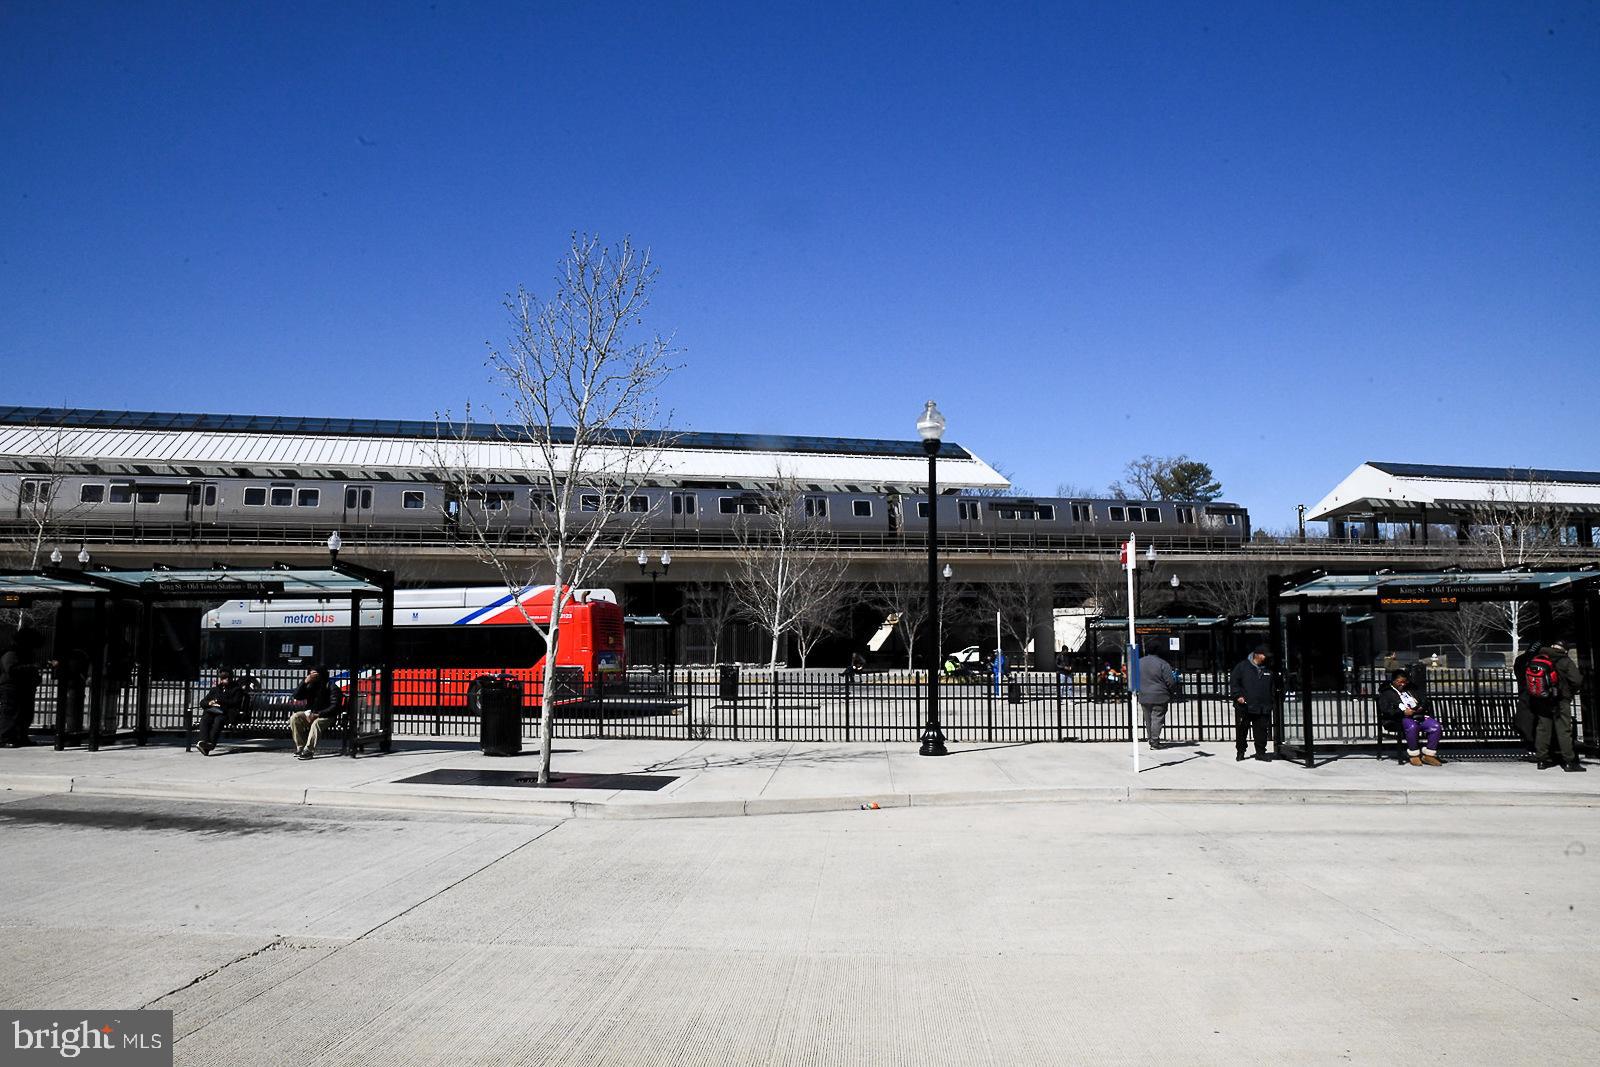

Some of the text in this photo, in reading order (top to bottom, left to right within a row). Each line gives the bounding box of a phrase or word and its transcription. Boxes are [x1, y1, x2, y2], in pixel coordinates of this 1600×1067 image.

[159, 583, 175, 592] King
[218, 582, 241, 590] Station
[1399, 586, 1416, 595] King
[1467, 585, 1492, 593] Station
[1498, 585, 1511, 593] Bay
[284, 613, 335, 624] metrobus
